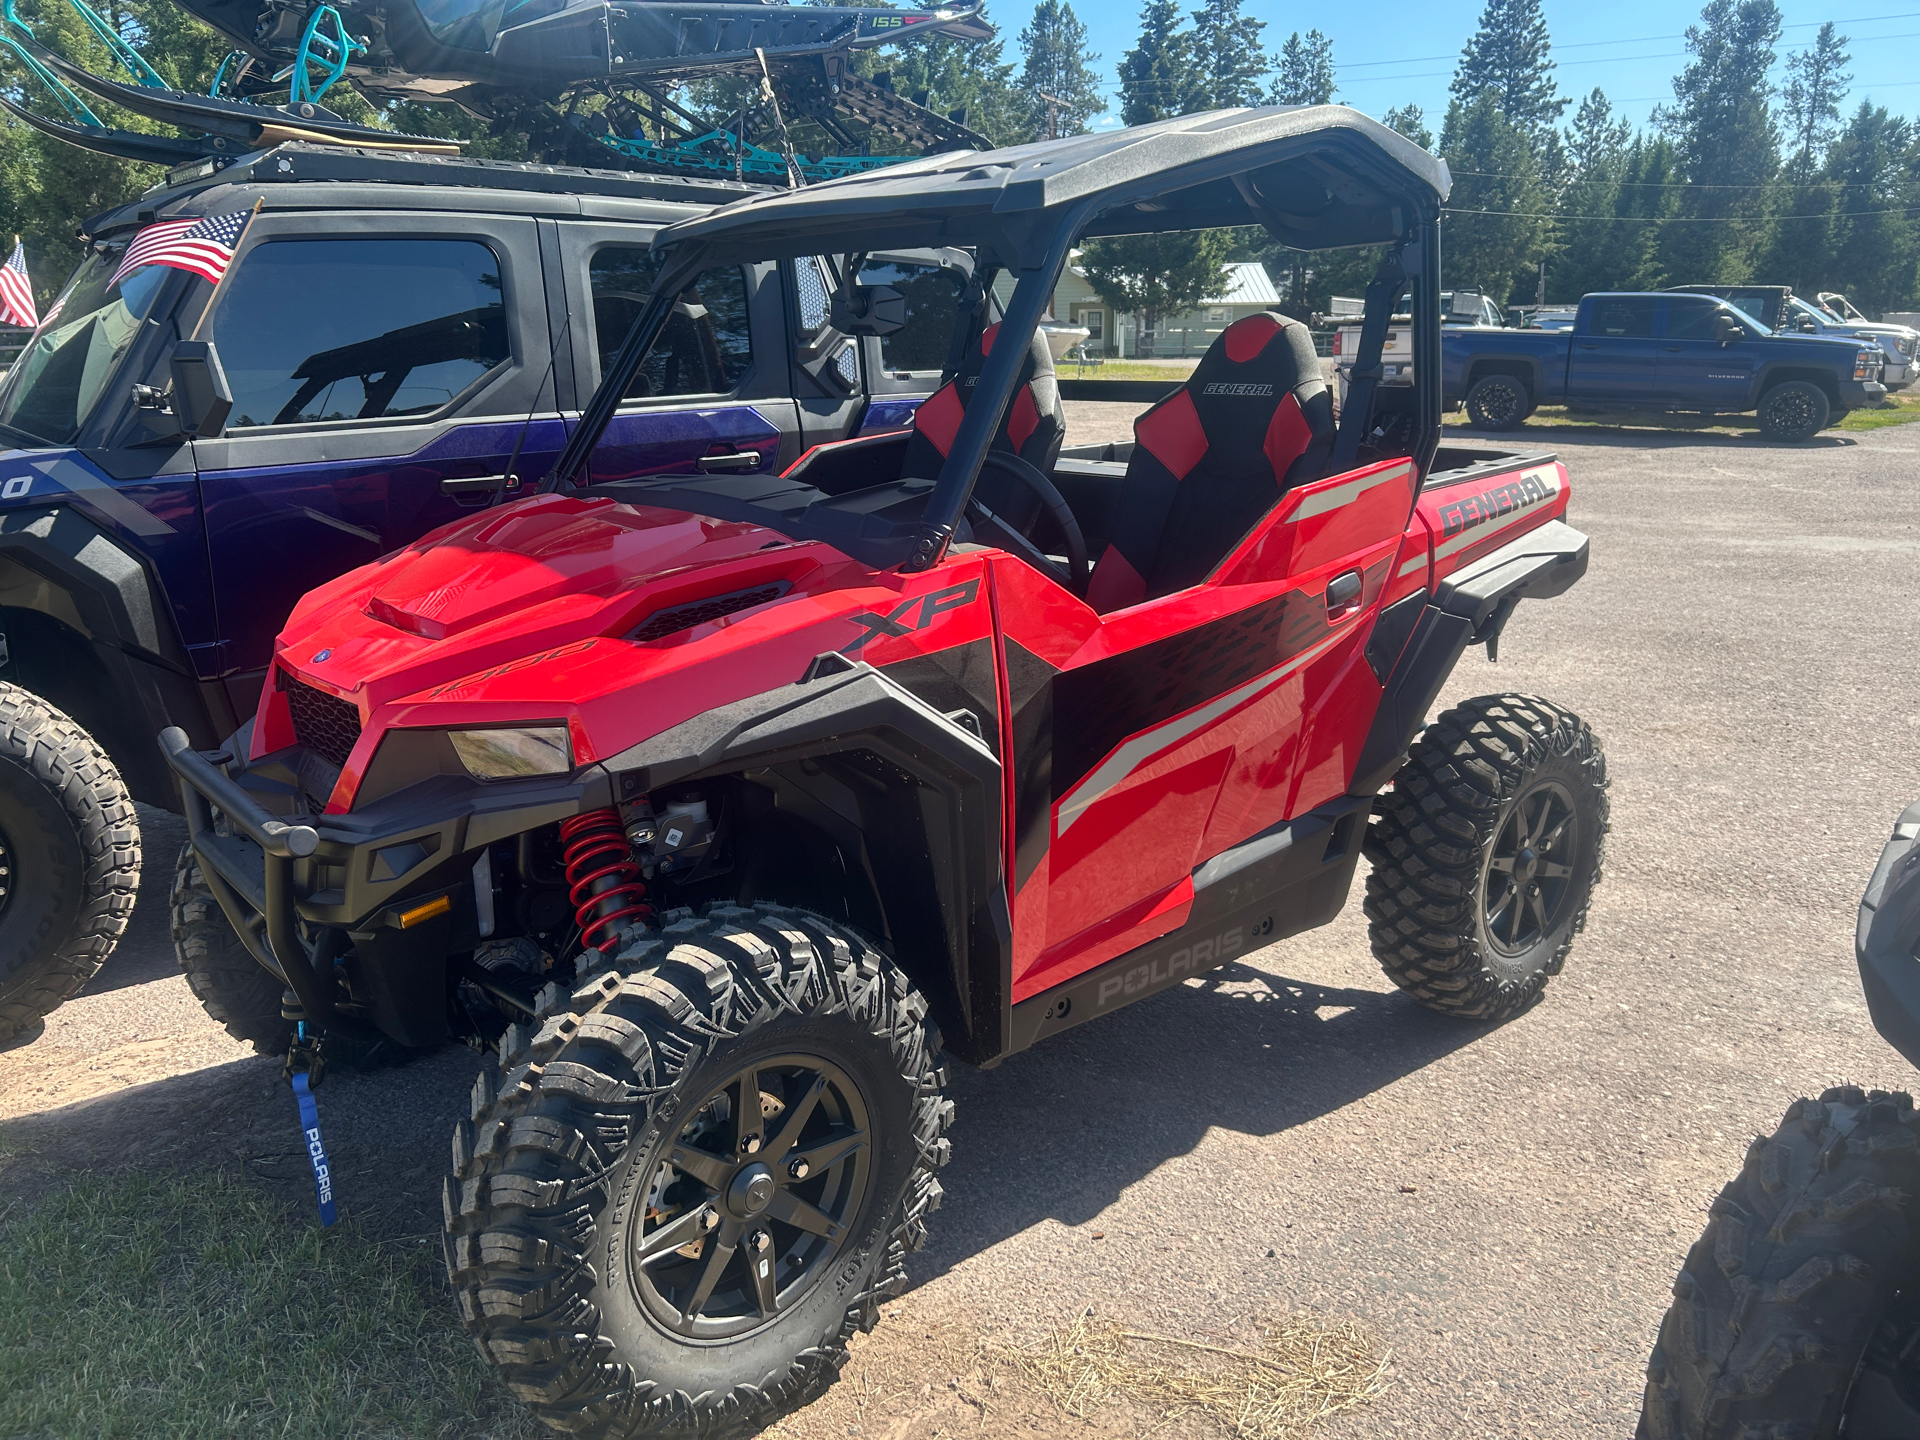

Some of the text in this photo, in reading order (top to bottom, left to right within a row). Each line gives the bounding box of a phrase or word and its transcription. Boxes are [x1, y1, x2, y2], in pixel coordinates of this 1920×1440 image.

[872, 16, 902, 28] 155
[1202, 382, 1274, 397] GENERAL
[1438, 474, 1556, 539] GENERAL
[839, 576, 982, 654] XP
[427, 639, 599, 699] 1000
[1098, 926, 1244, 1008] POLARIS
[305, 1126, 332, 1205] POLARIS
